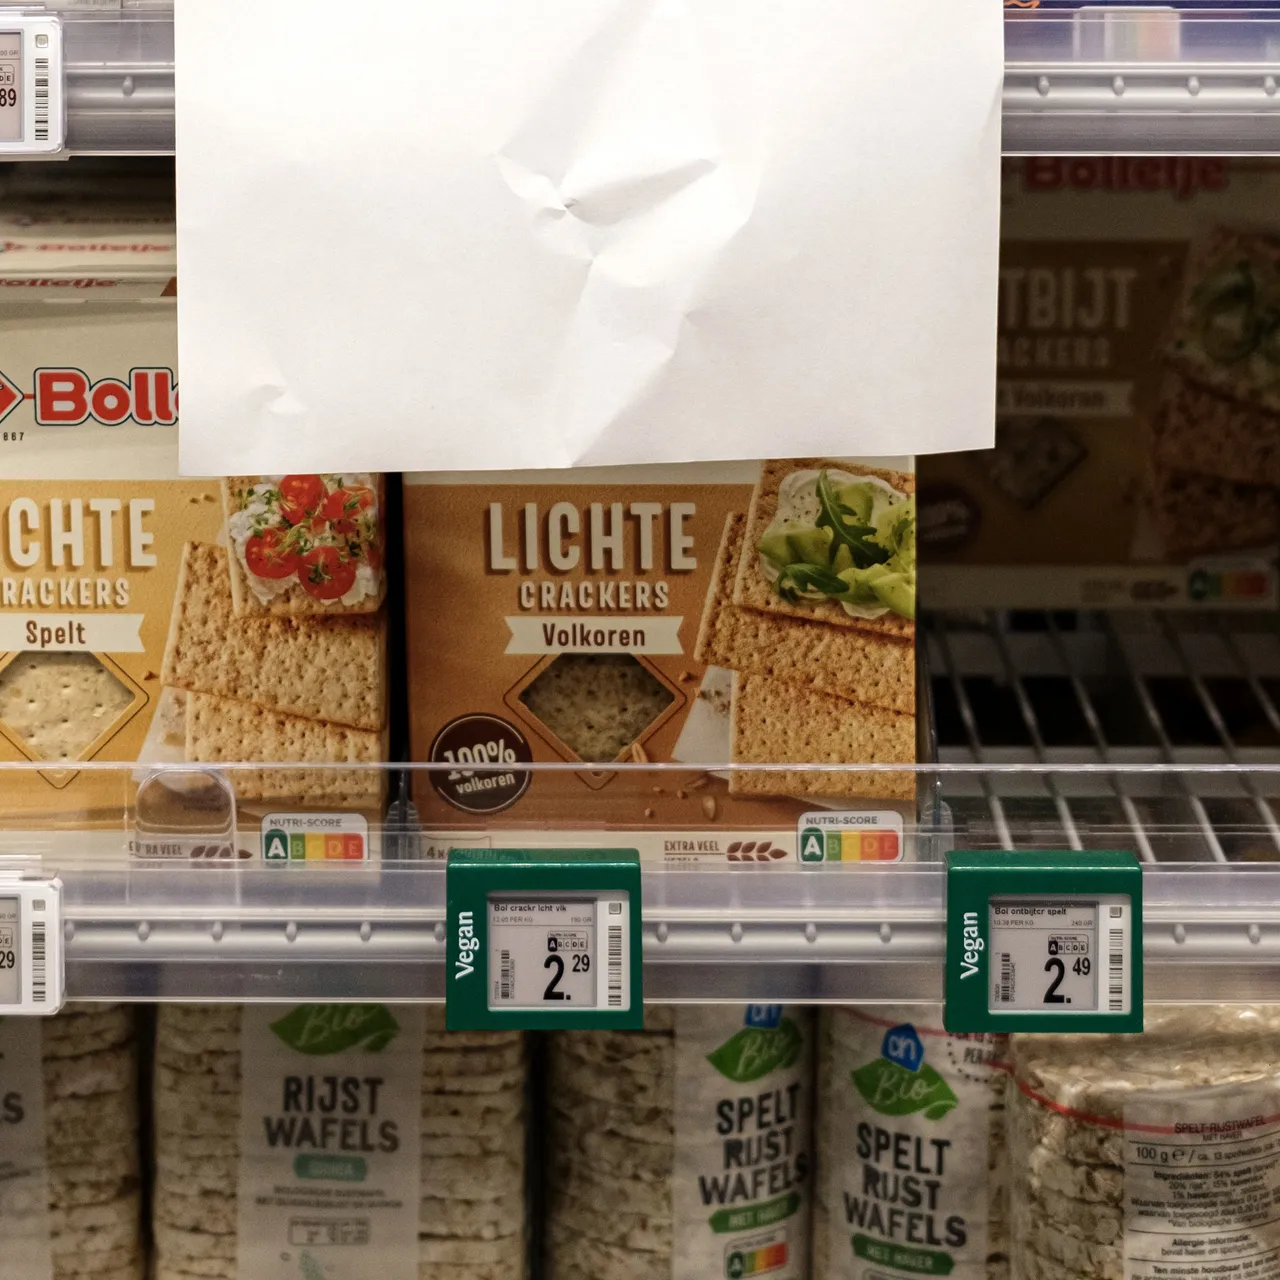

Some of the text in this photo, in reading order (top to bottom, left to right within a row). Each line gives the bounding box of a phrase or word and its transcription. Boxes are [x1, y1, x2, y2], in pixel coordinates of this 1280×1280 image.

[487, 501, 698, 572] LICHTE
[519, 580, 670, 611] CRACKERS
[25, 620, 86, 647] Spelt
[542, 623, 646, 648] Volkoren
[455, 771, 516, 795] volkoren
[806, 816, 878, 826] NUTRI-SCORE
[494, 904, 507, 912] Bol
[510, 904, 535, 912] crackr
[455, 911, 479, 980] Vegan
[1073, 957, 1090, 976] 49
[282, 1077, 383, 1116] RIJST
[874, 1067, 937, 1110] Bio
[264, 1118, 399, 1153] WAFELS
[856, 1124, 951, 1177] SPELT
[863, 1169, 940, 1209] RIJST
[843, 1200, 967, 1248] WAFELS
